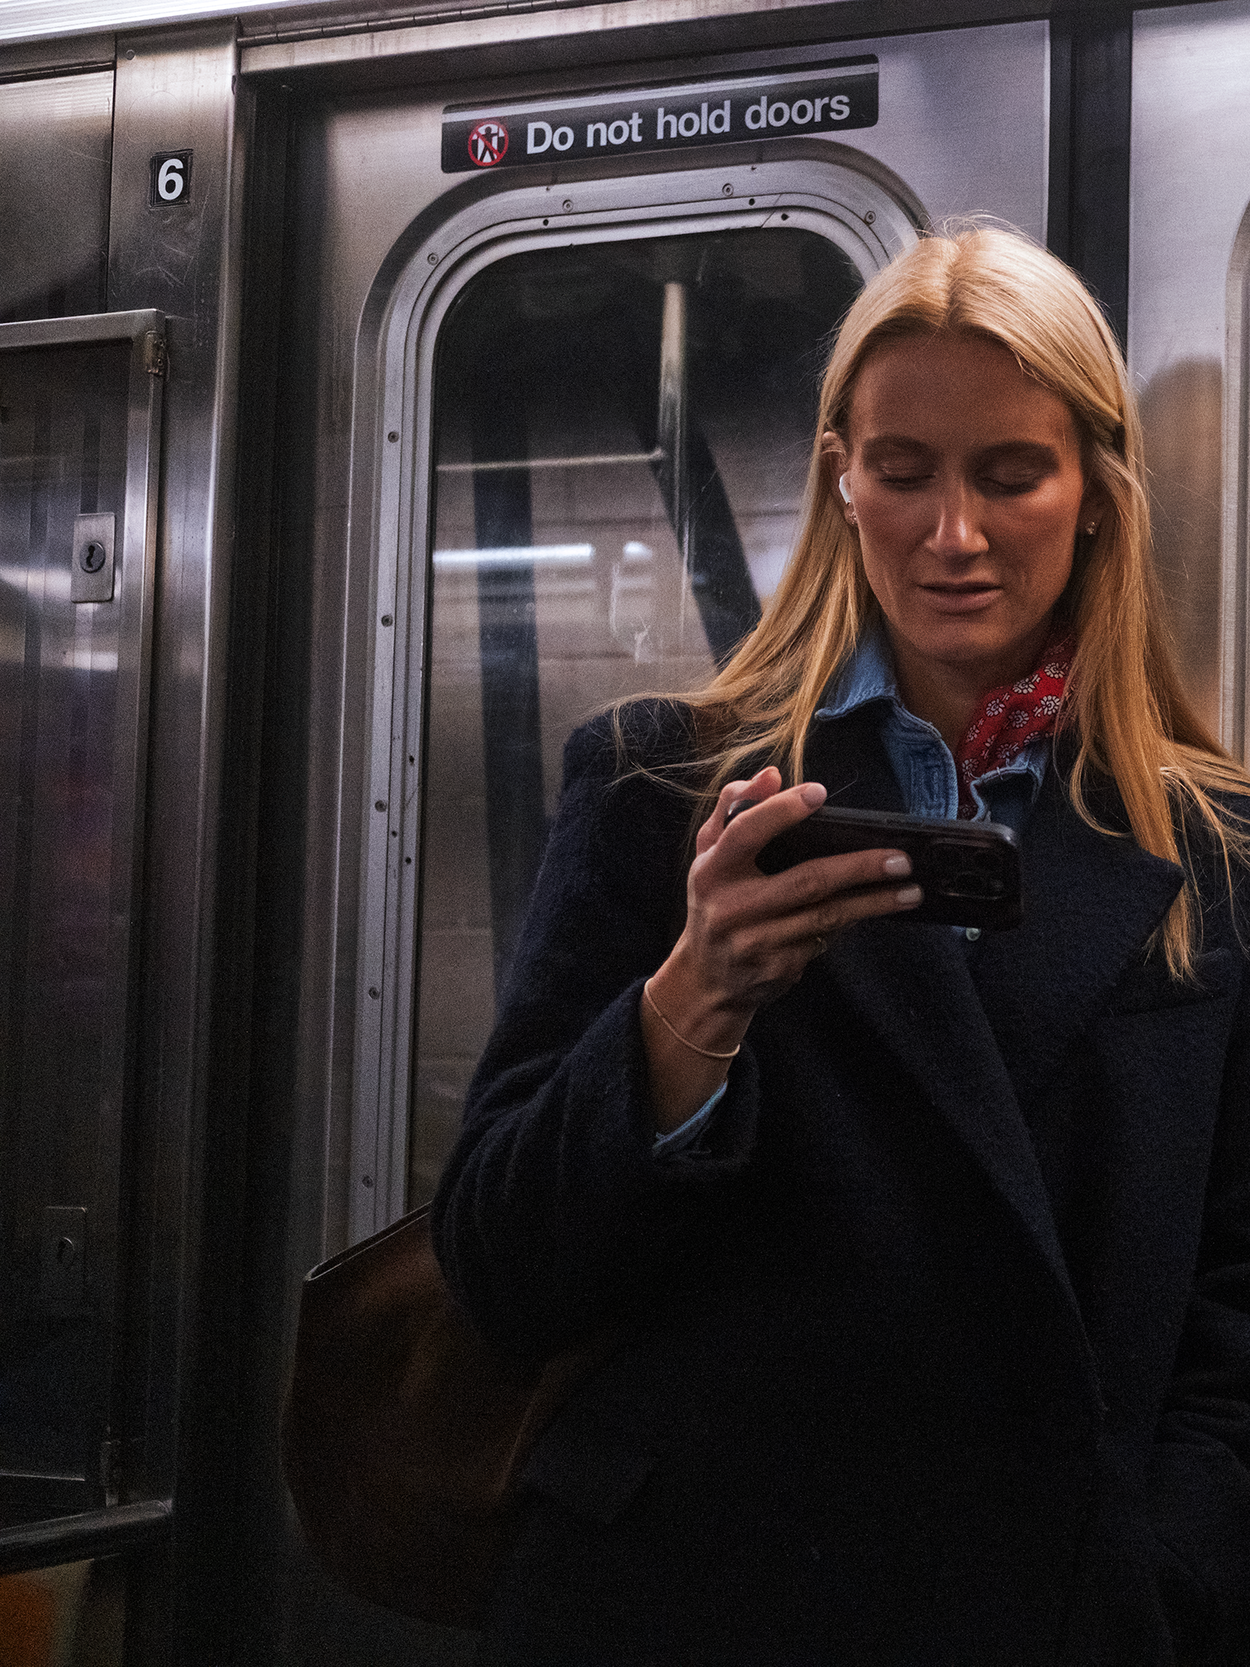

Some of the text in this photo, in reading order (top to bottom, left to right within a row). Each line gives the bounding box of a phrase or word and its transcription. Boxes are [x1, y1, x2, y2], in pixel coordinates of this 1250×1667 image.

[526, 94, 851, 155] Do not hold doors
[158, 158, 184, 201] 6
